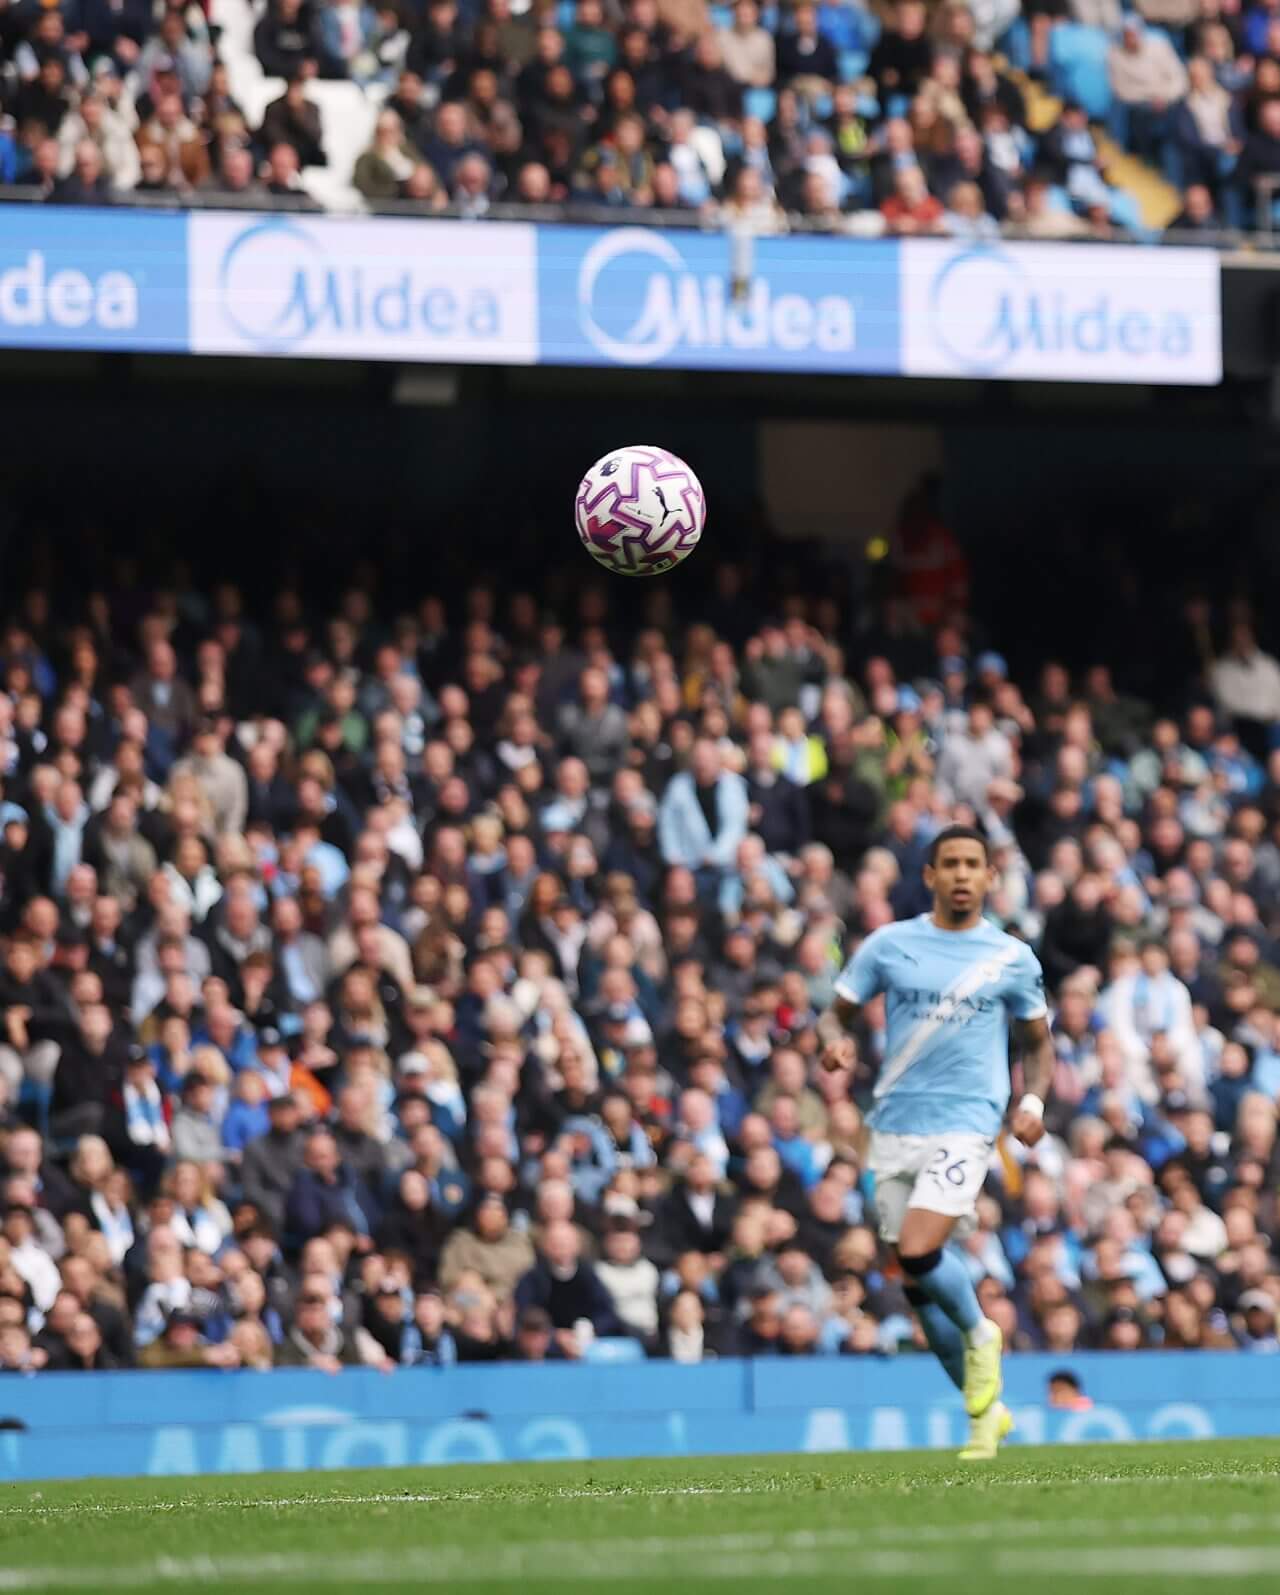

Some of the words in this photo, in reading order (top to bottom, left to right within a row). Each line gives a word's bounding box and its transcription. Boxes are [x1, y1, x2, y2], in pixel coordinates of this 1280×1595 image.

[278, 266, 501, 335] Midea
[630, 271, 856, 351] Midea
[978, 289, 1193, 355] Midea
[926, 1147, 967, 1195] 26
